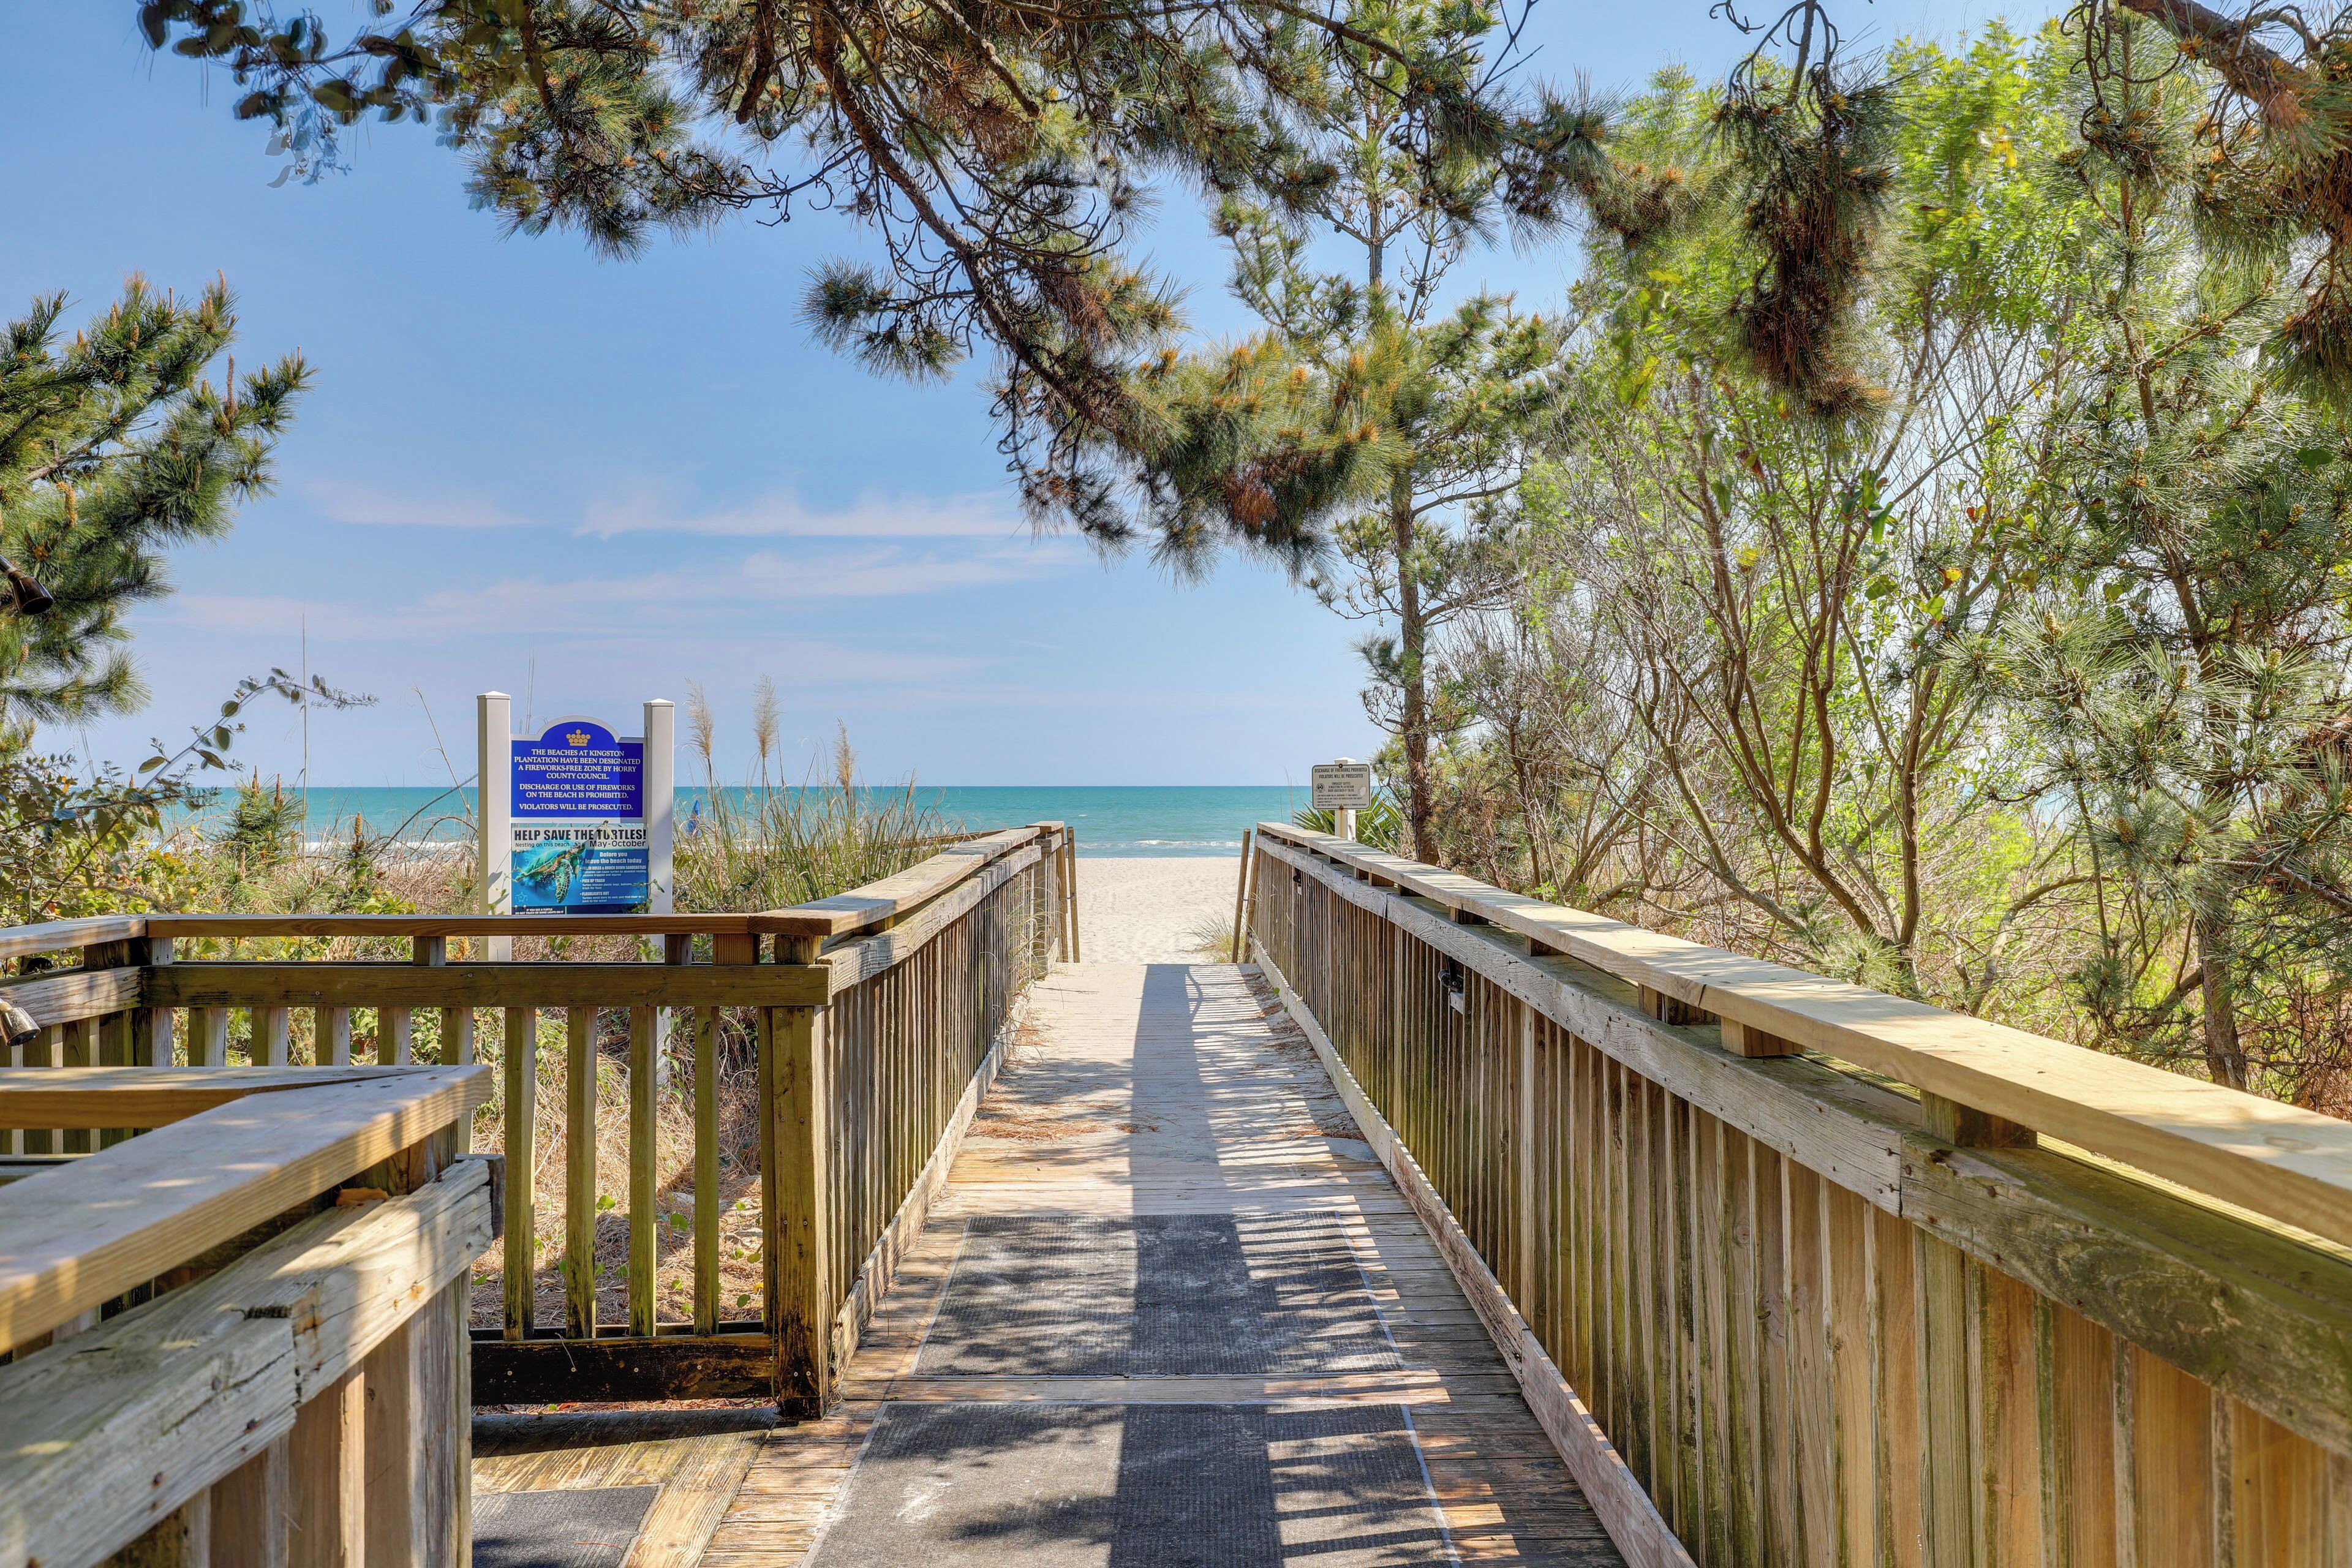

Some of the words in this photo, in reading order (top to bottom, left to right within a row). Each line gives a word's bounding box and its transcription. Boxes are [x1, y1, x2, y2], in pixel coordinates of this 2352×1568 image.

[514, 830, 540, 840] HELP
[544, 830, 571, 840] SAVE
[576, 830, 594, 840] THE
[598, 829, 646, 840] TURTLES!
